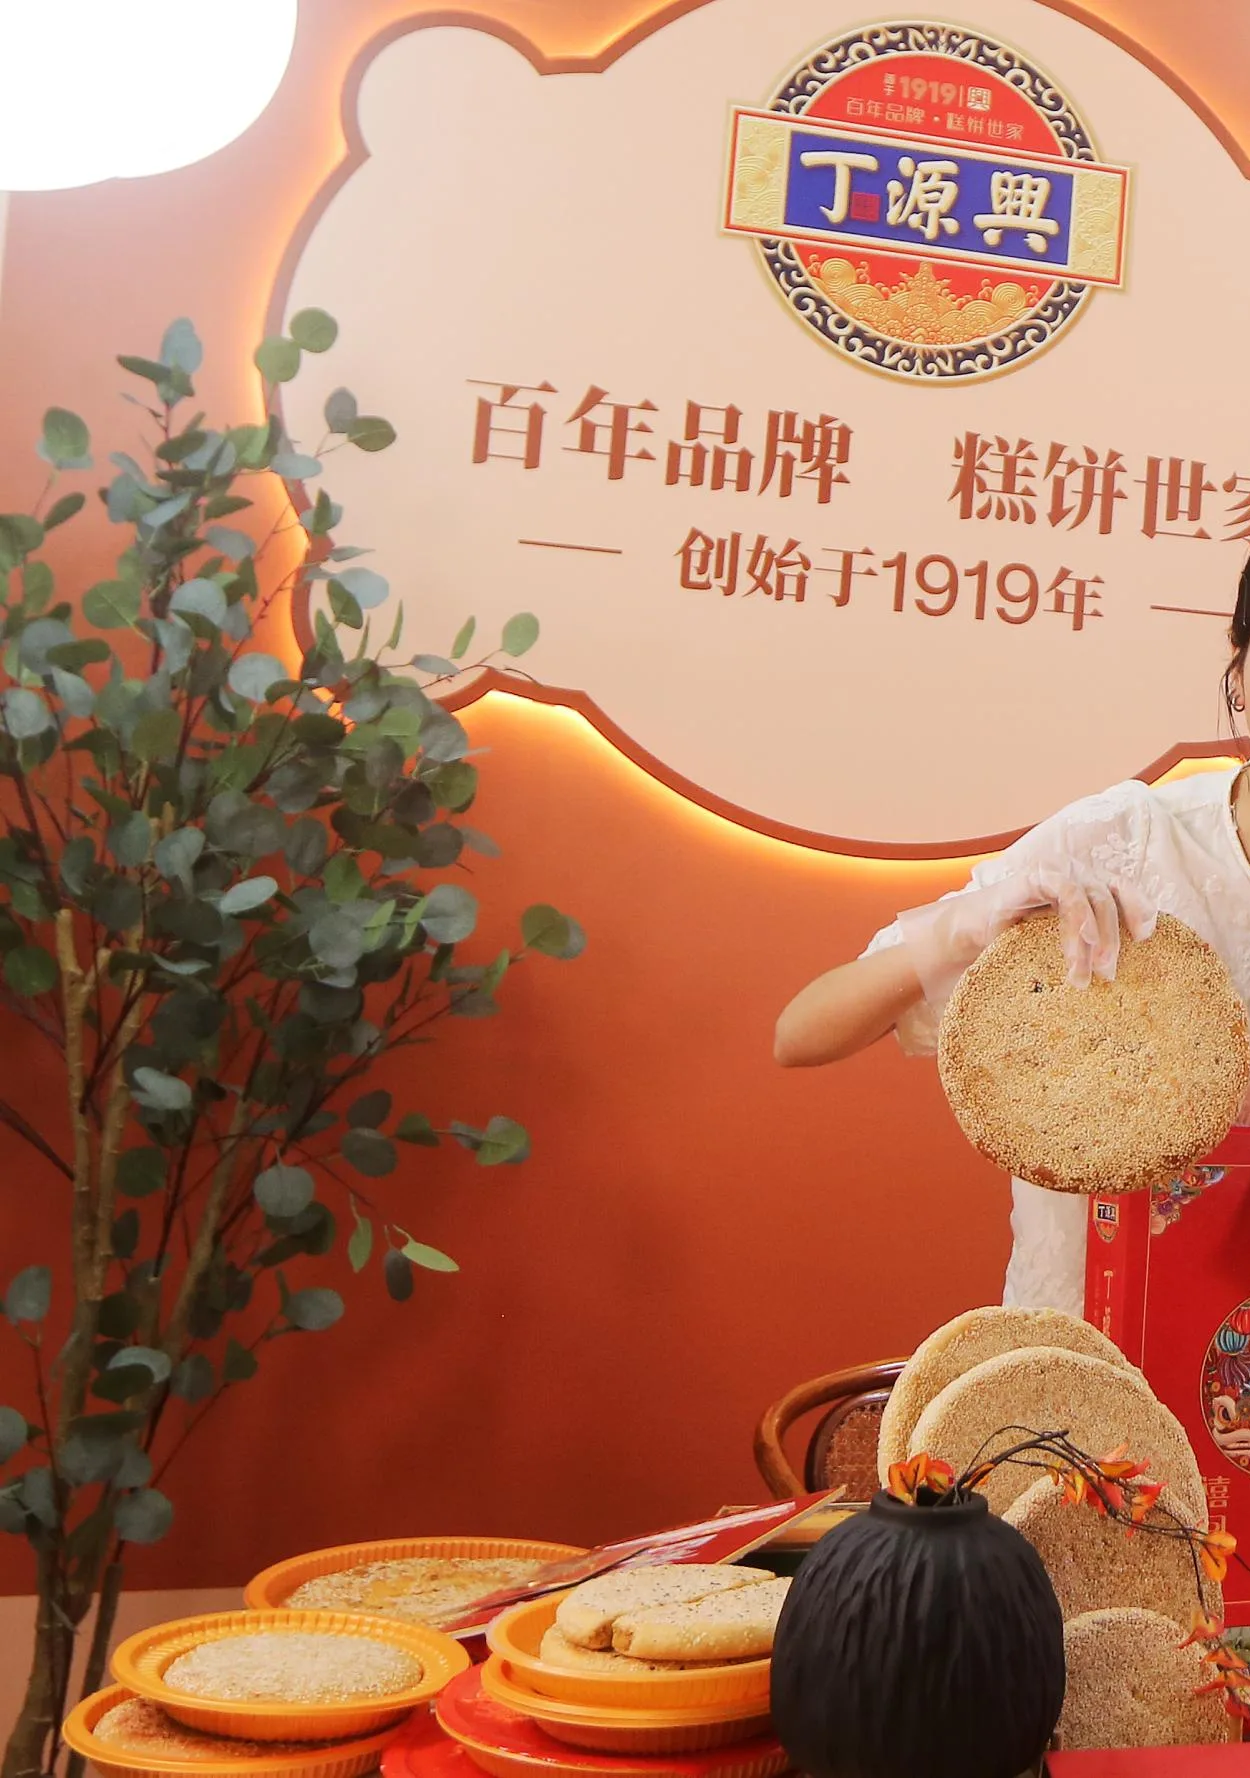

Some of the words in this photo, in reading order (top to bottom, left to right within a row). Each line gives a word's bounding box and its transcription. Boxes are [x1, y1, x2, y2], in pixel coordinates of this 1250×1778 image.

[900, 75, 957, 106] 1919
[799, 151, 1060, 254] 丁源興
[466, 379, 855, 505] 百年品牌
[673, 525, 1105, 632] 创始于1919年
